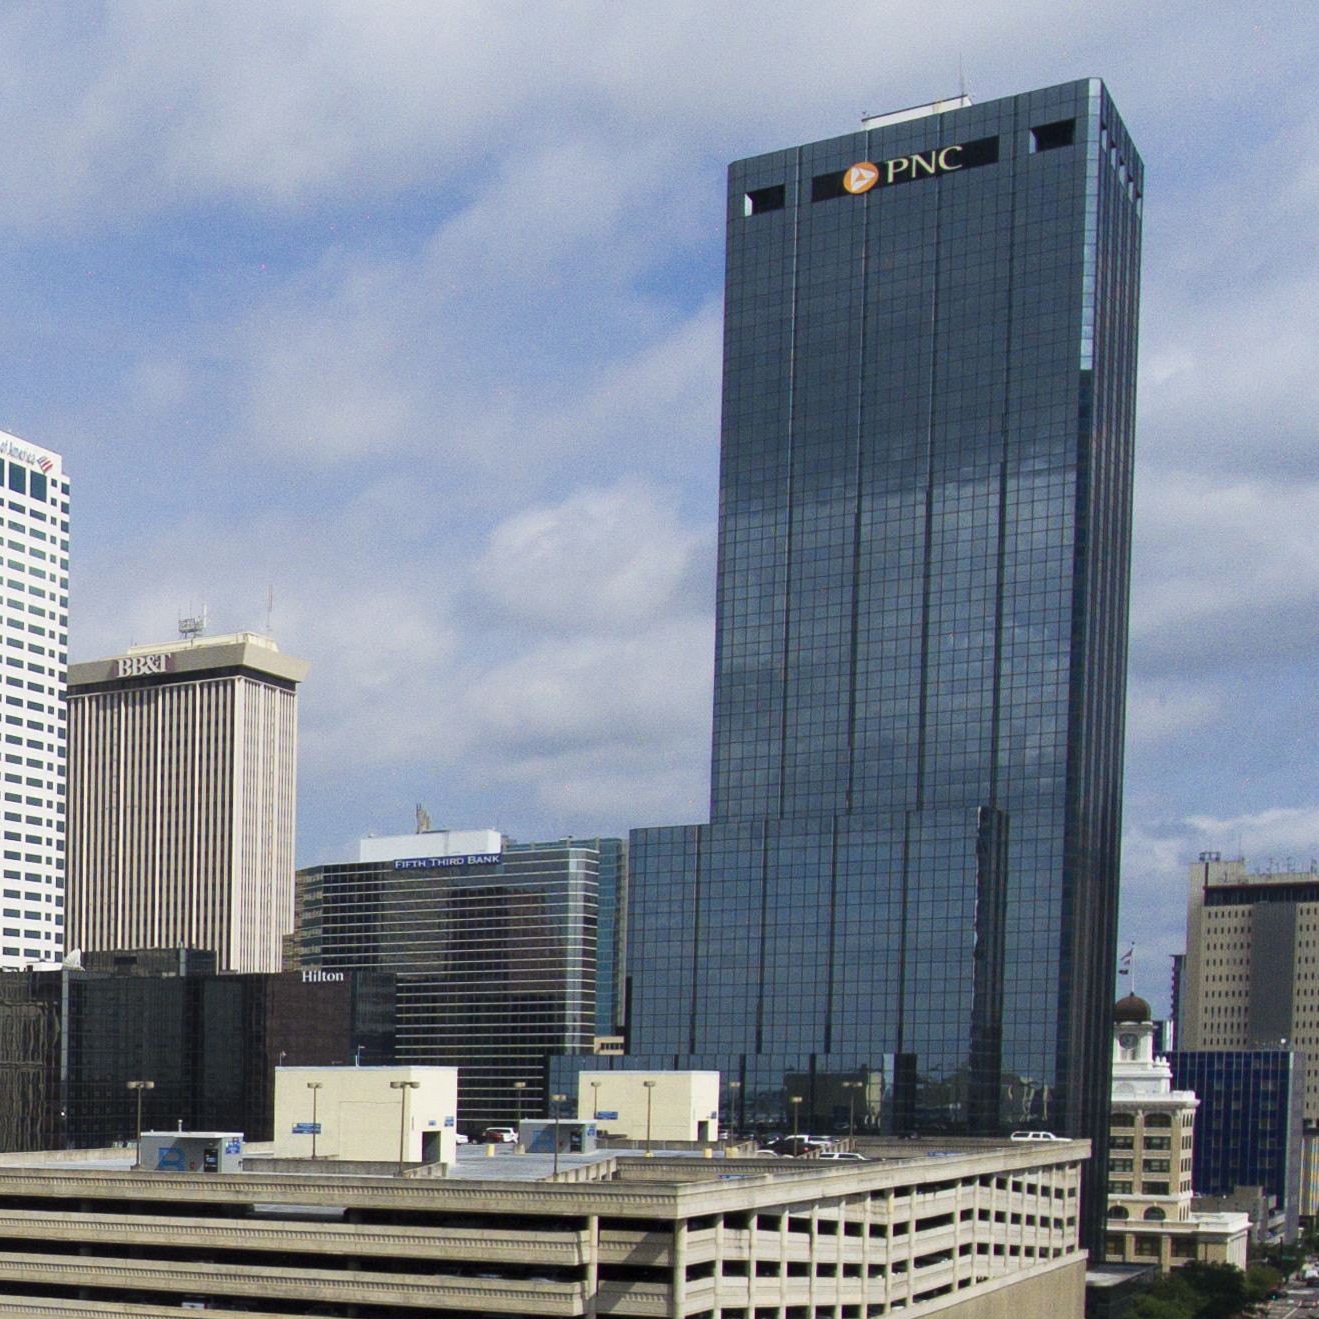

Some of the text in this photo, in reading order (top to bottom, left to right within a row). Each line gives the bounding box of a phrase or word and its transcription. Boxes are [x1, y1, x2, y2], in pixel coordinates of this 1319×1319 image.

[886, 145, 963, 184] PNC
[7, 442, 35, 465] America
[117, 653, 171, 678] BB&T
[395, 855, 500, 869] FIFTH THIRD BANK
[302, 970, 344, 982] Hilton
